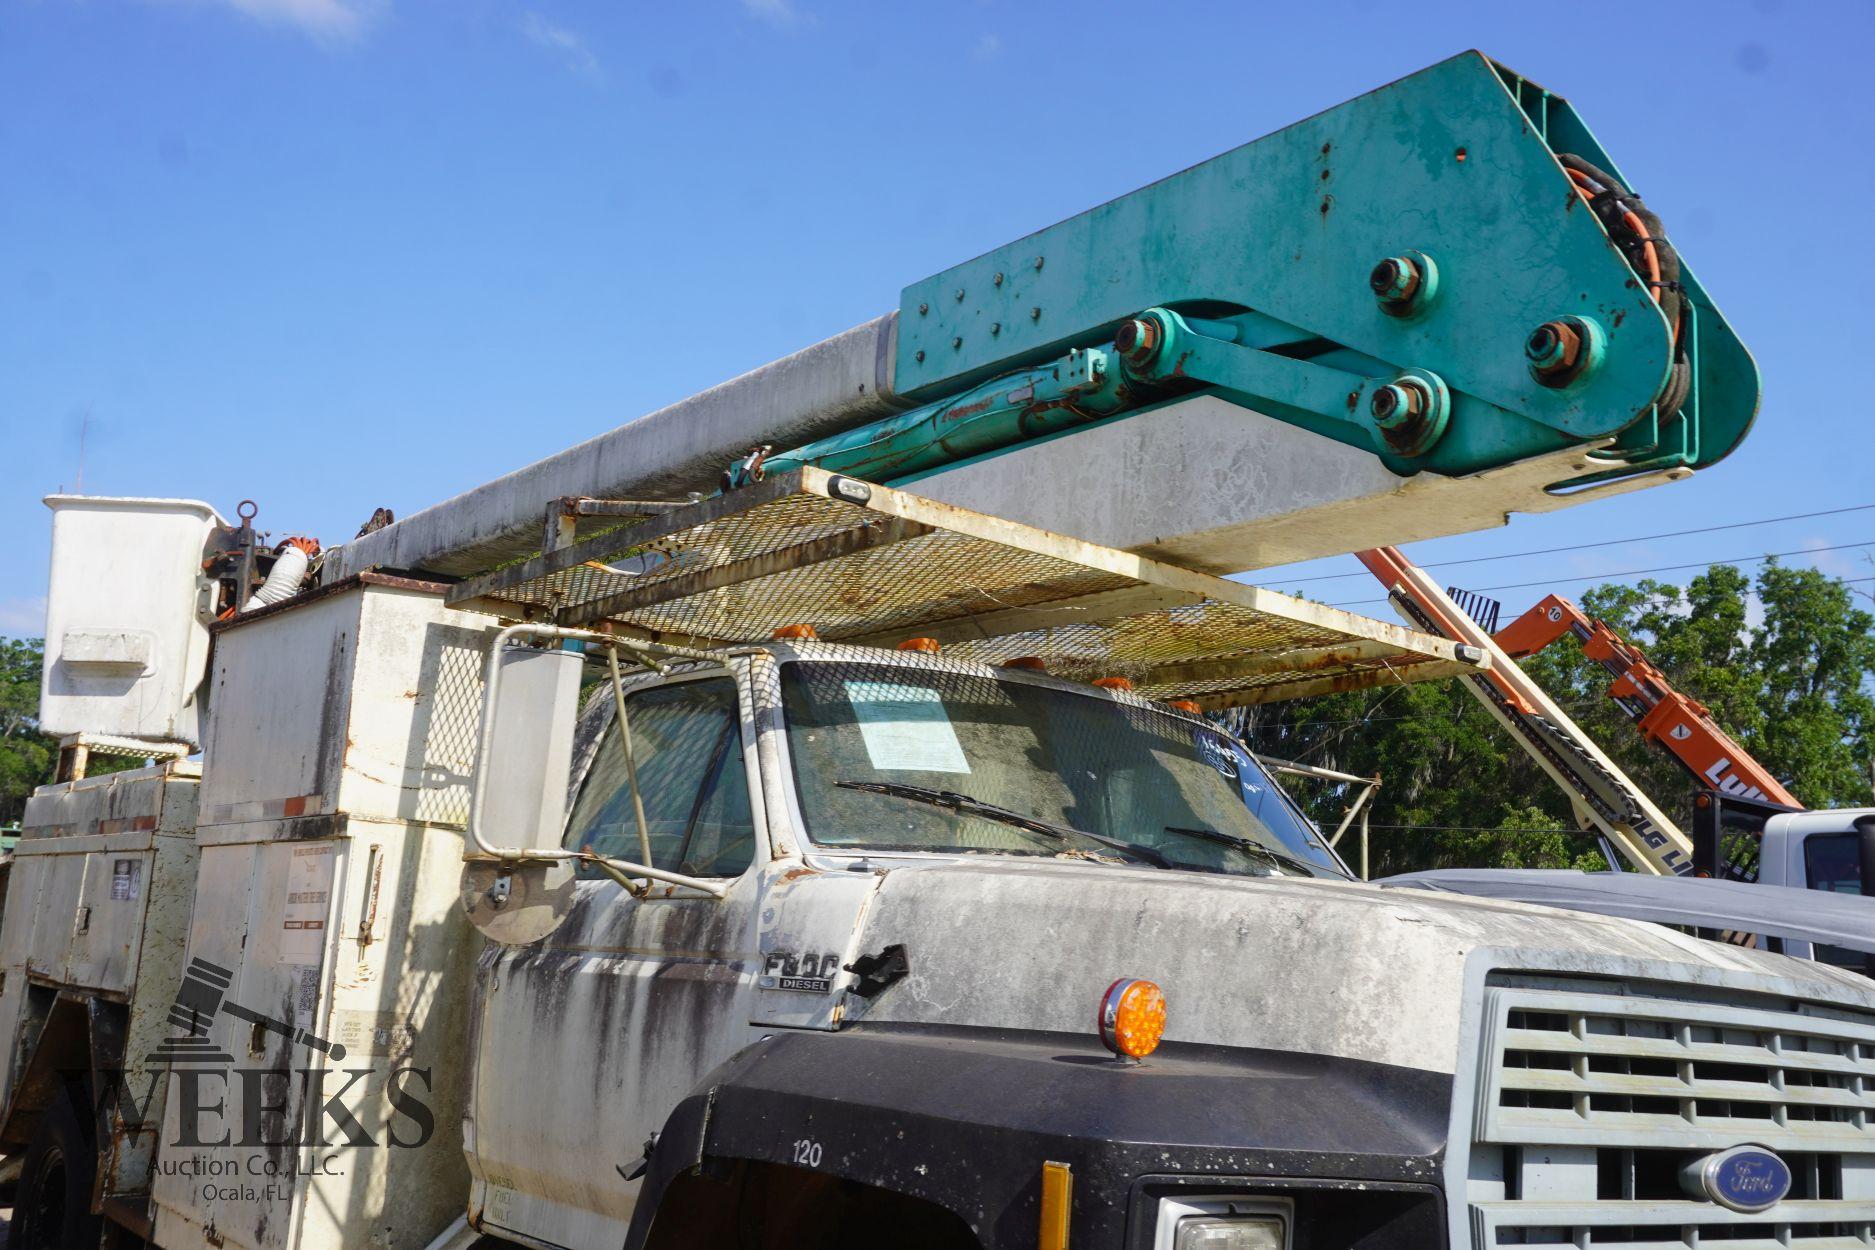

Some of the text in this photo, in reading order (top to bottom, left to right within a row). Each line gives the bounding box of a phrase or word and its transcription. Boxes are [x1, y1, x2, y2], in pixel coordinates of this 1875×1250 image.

[1550, 608, 1560, 620] 10
[782, 979, 828, 991] DIESEL
[793, 1139, 823, 1168] 120
[1730, 1159, 1774, 1193] Ford
